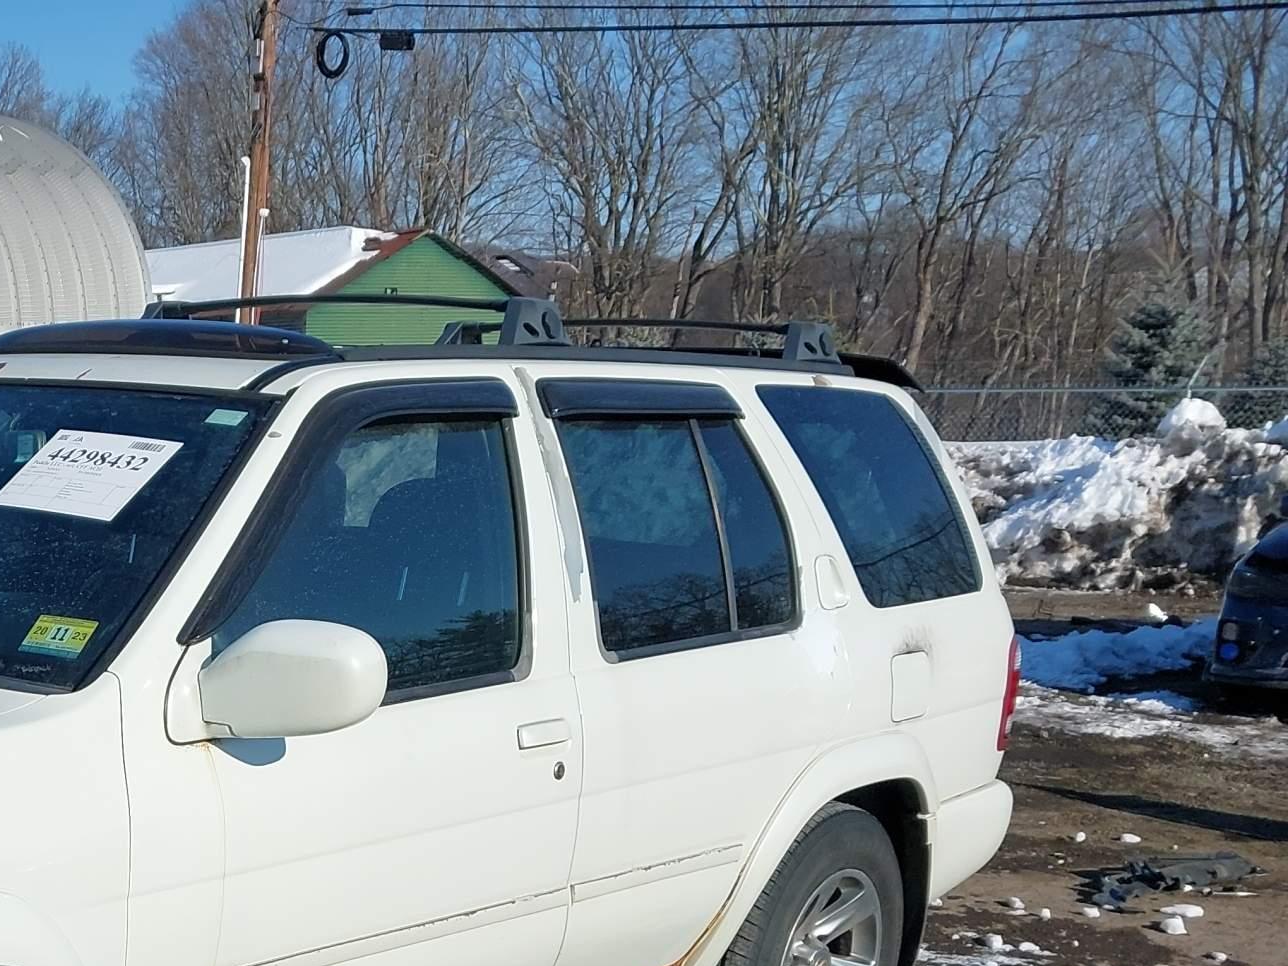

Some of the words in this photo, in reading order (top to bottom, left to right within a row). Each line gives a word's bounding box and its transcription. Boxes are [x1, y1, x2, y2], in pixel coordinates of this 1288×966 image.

[48, 447, 149, 471] 44298432
[33, 625, 49, 636] 20
[51, 626, 70, 641] 11
[72, 631, 88, 641] 23
